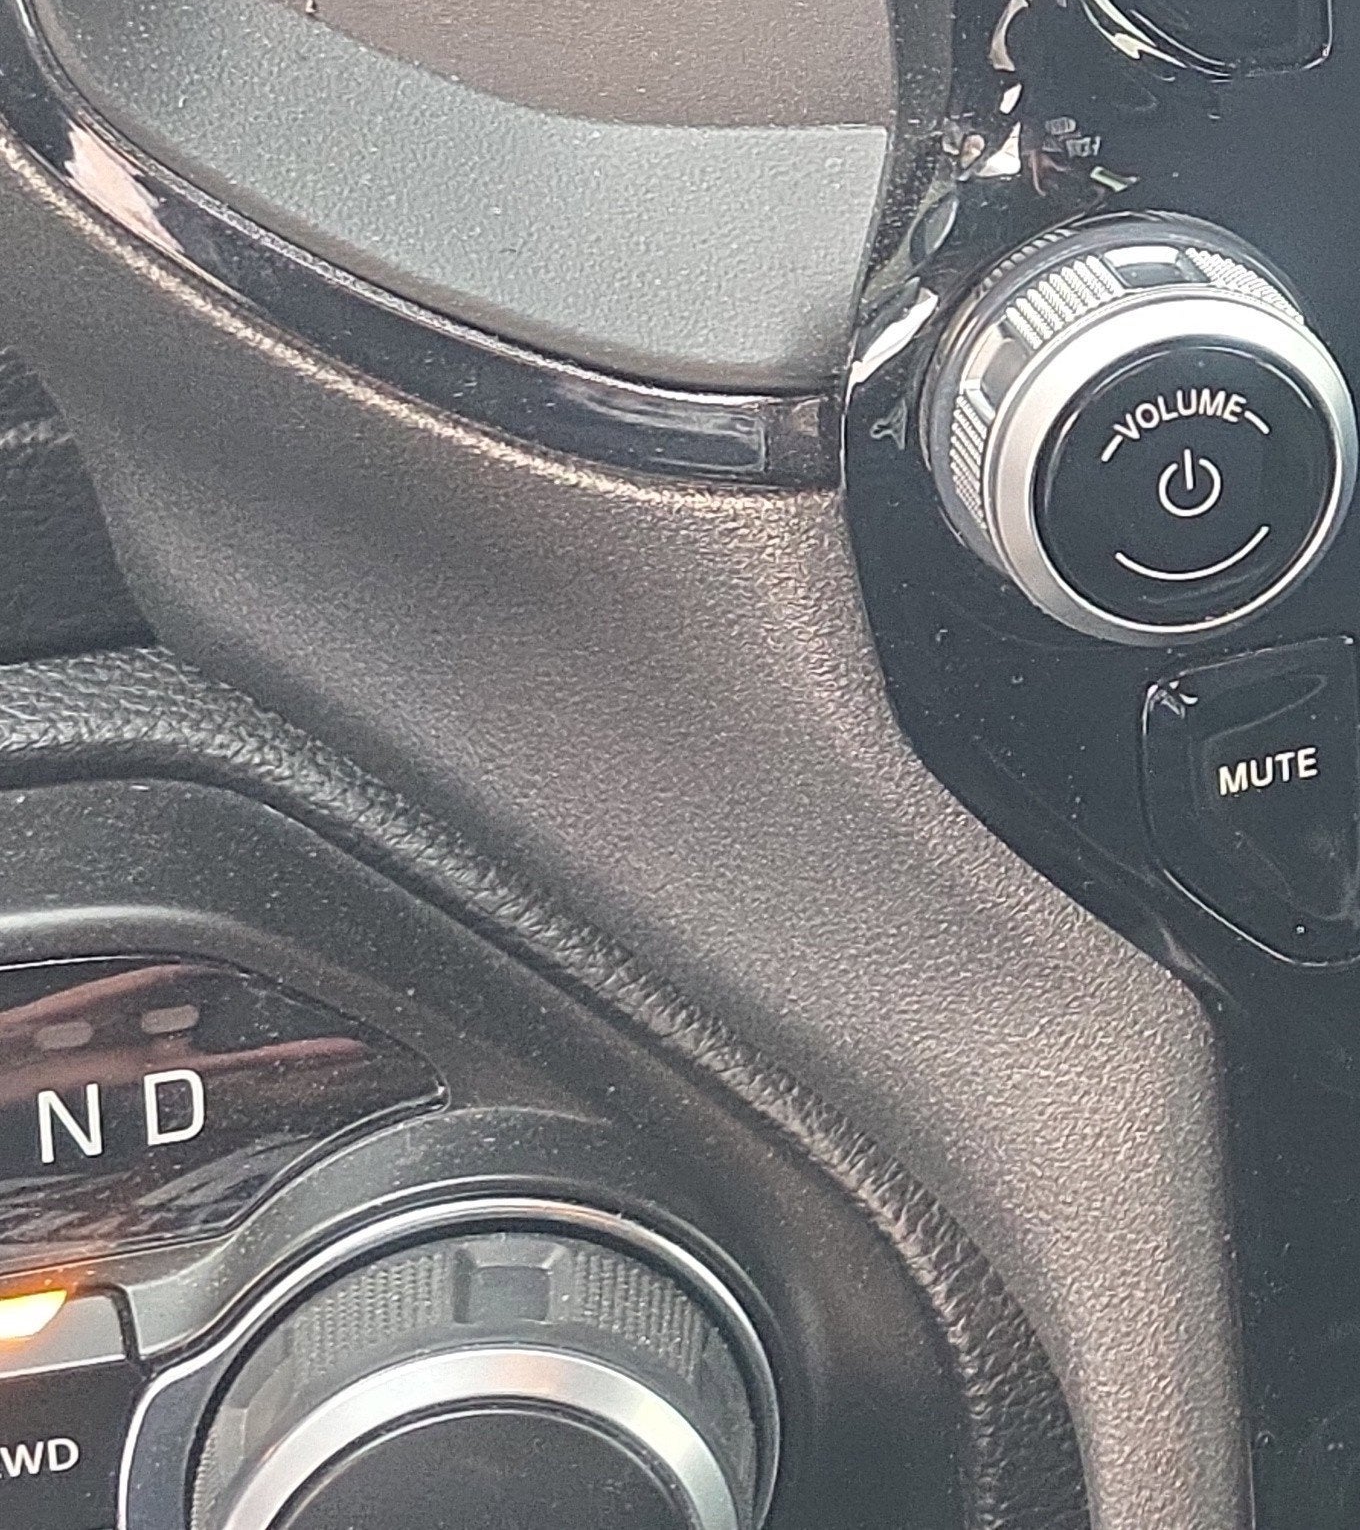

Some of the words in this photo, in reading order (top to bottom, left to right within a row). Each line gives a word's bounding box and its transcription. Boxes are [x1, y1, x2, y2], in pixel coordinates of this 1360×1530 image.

[1114, 388, 1248, 442] VOLUME
[1218, 746, 1319, 796] MUTE
[37, 1083, 103, 1163] N
[143, 1069, 205, 1146] D
[0, 1437, 80, 1479] WD
